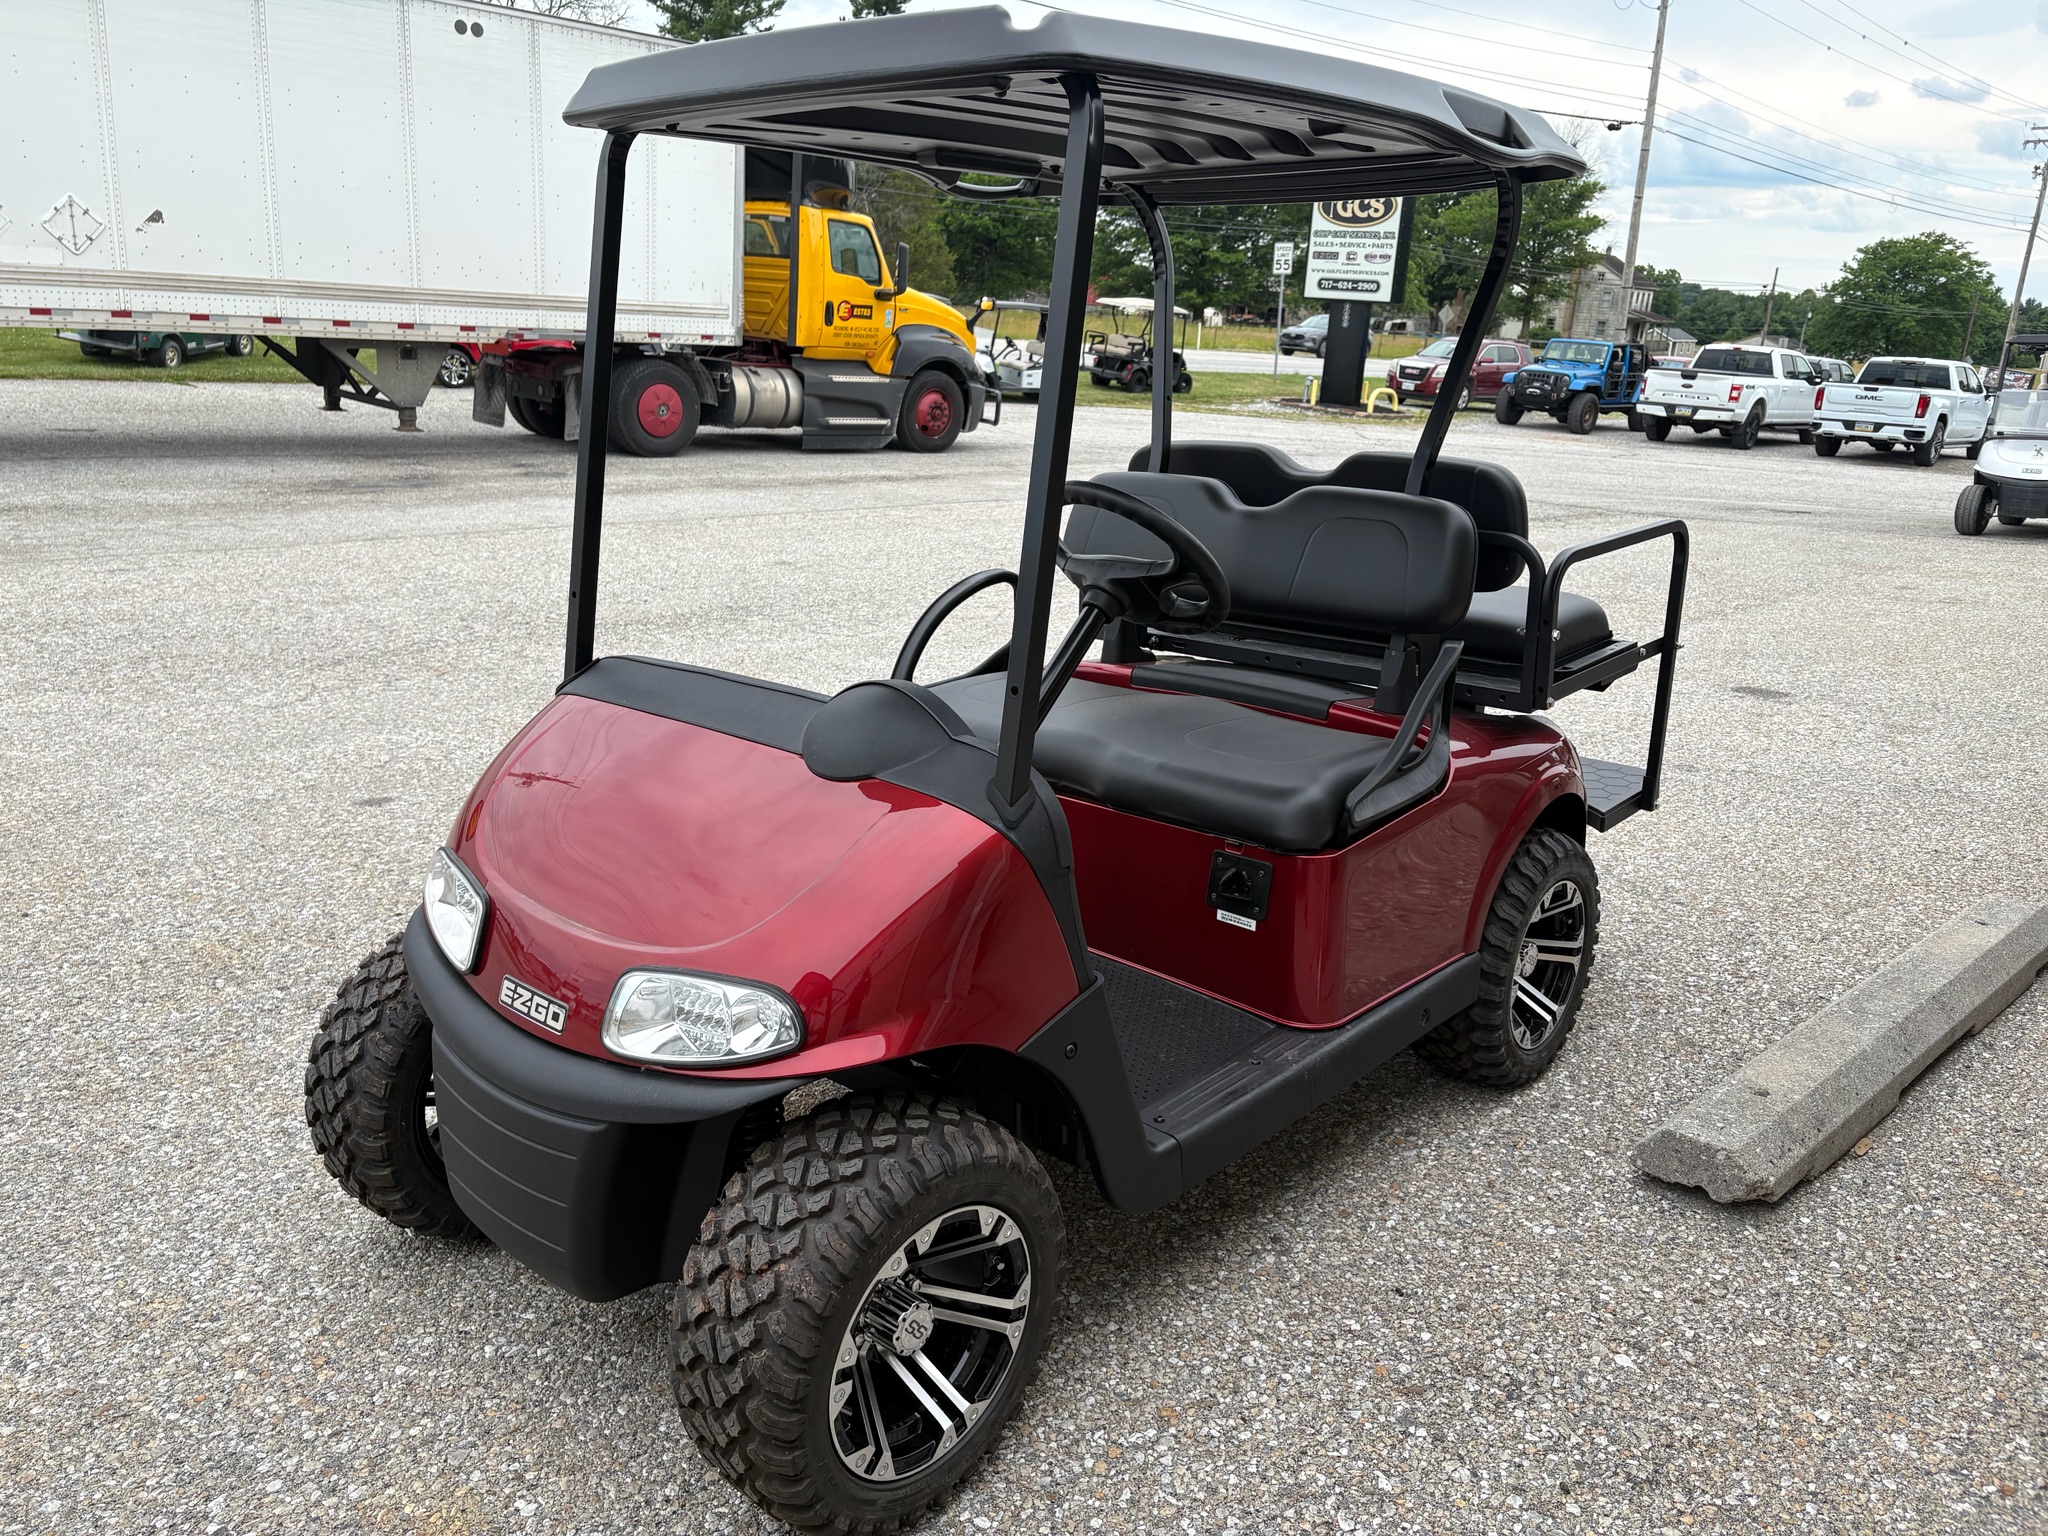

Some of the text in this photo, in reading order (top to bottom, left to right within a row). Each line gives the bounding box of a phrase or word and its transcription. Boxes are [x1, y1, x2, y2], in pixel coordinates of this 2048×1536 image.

[1337, 198, 1385, 218] GCS
[1331, 230, 1349, 239] CART
[1371, 242, 1394, 250] PARTS
[1275, 259, 1291, 271] 55
[1320, 280, 1378, 291] 717-624-2900
[853, 307, 871, 316] ESTES
[499, 979, 566, 1031] EZGO
[905, 1319, 928, 1340] SS
